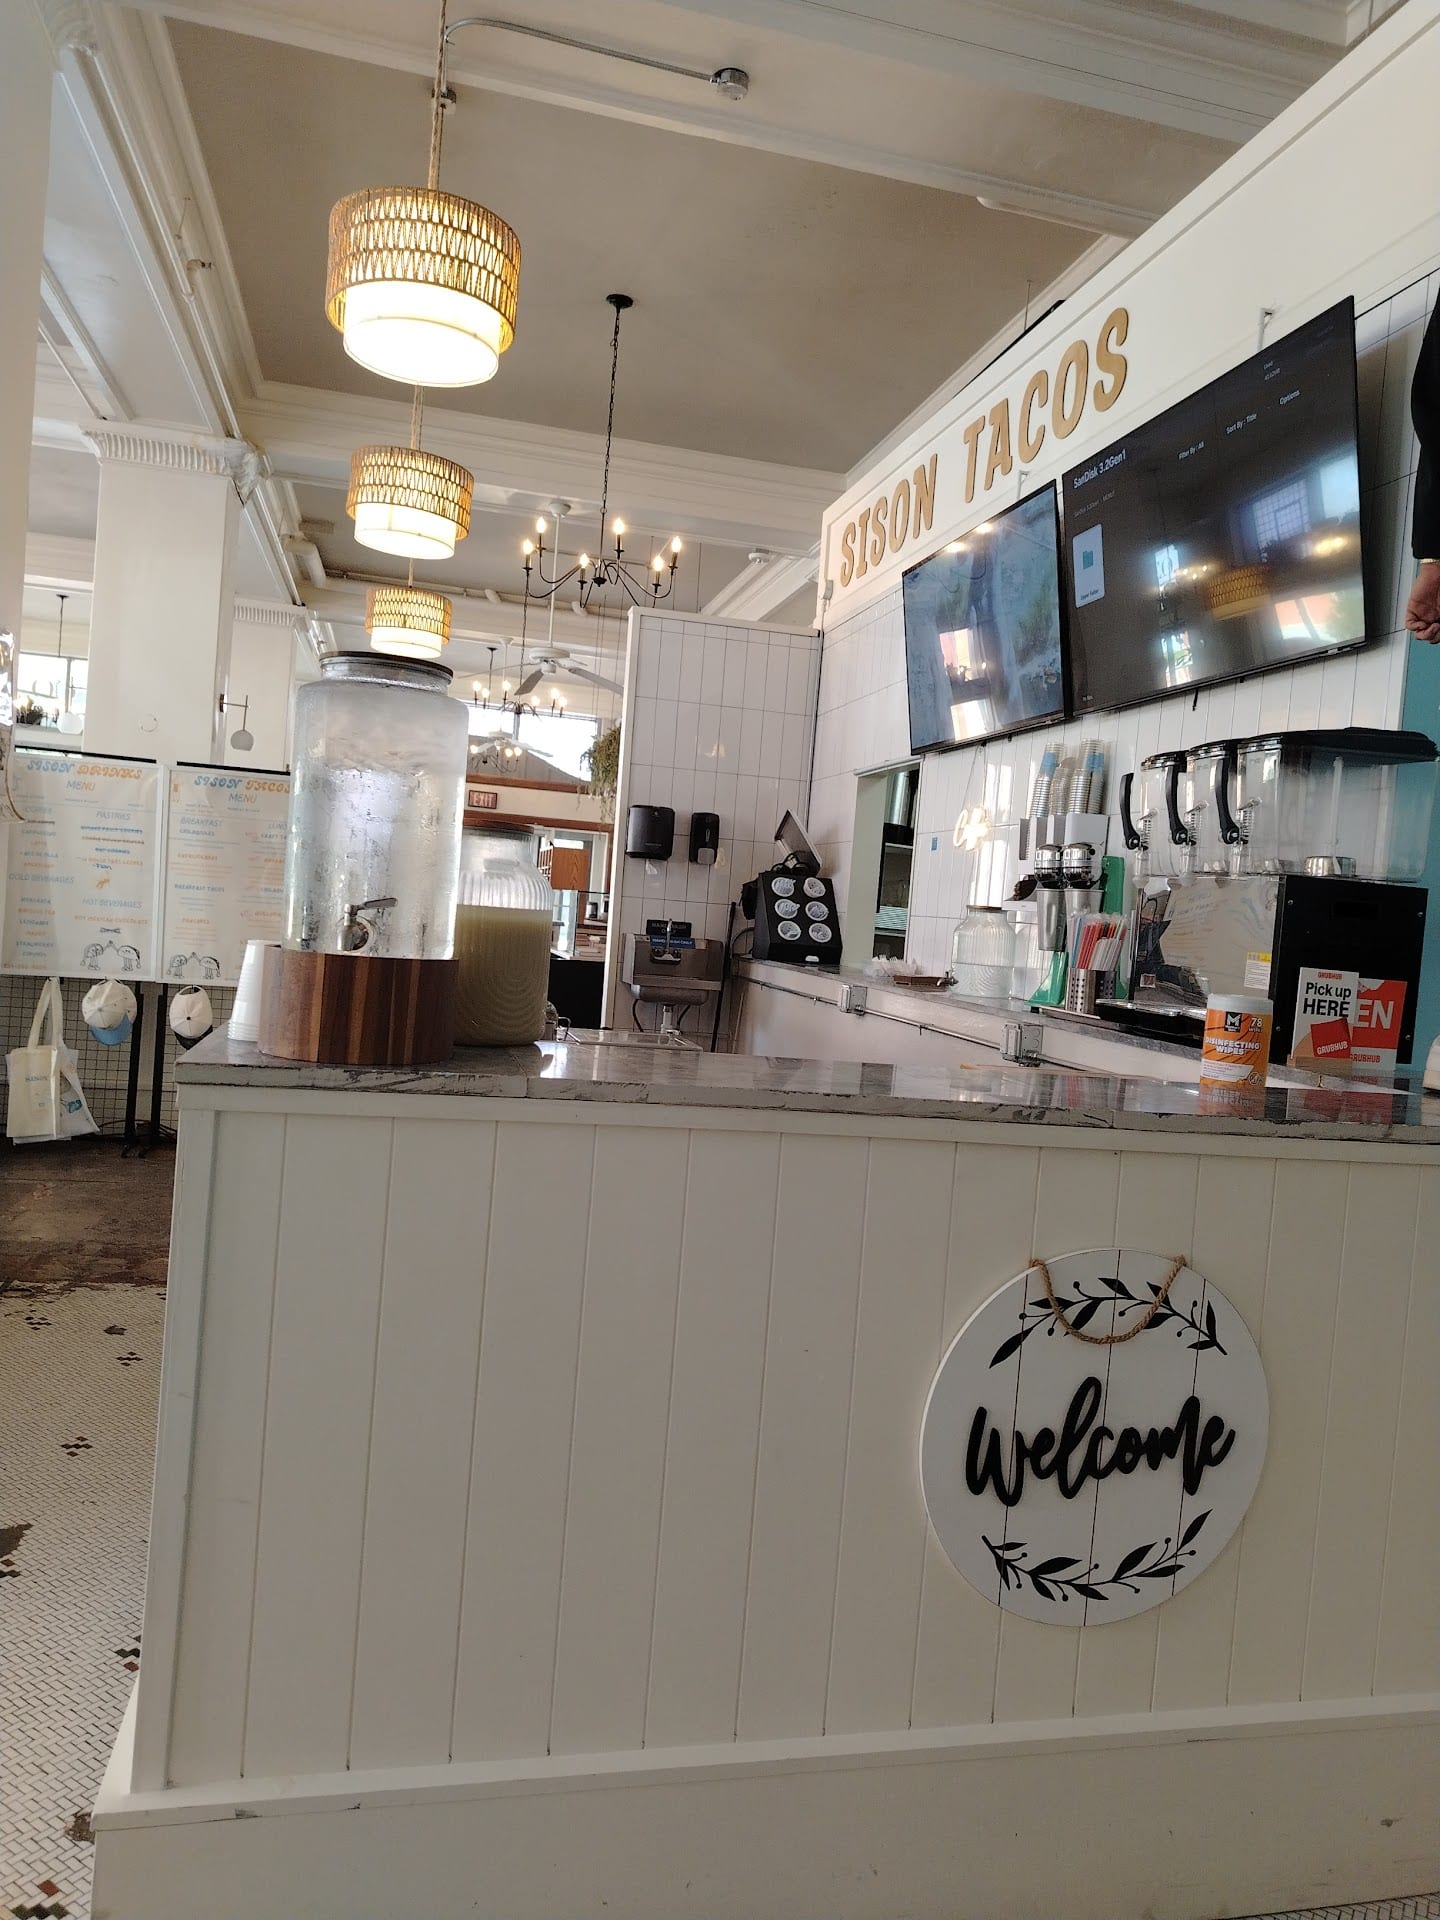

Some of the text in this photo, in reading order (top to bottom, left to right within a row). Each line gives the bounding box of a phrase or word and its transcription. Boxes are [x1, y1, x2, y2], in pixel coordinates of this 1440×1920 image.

[1279, 390, 1301, 405] Options
[840, 307, 1129, 587] SISON TACOS
[1073, 448, 1126, 489] SanDisk 3.2Gen1
[65, 780, 96, 792] MENU
[194, 775, 242, 789] SISON
[228, 792, 259, 804] MENU
[473, 792, 495, 808] EXIT
[95, 810, 132, 821] PASTRIES
[180, 817, 223, 827] BREAKFAST
[82, 898, 143, 909] HOT BEVERAGES
[1317, 971, 1343, 980] GRUBHUB
[1305, 981, 1352, 1001] Pick up
[1302, 997, 1351, 1018] HERE
[1354, 998, 1395, 1030] EN
[1250, 1016, 1263, 1028] 78
[1205, 1036, 1261, 1051] DISINFECTING
[1215, 1045, 1245, 1056] WIPES
[1316, 1040, 1349, 1056] GRUBHUB
